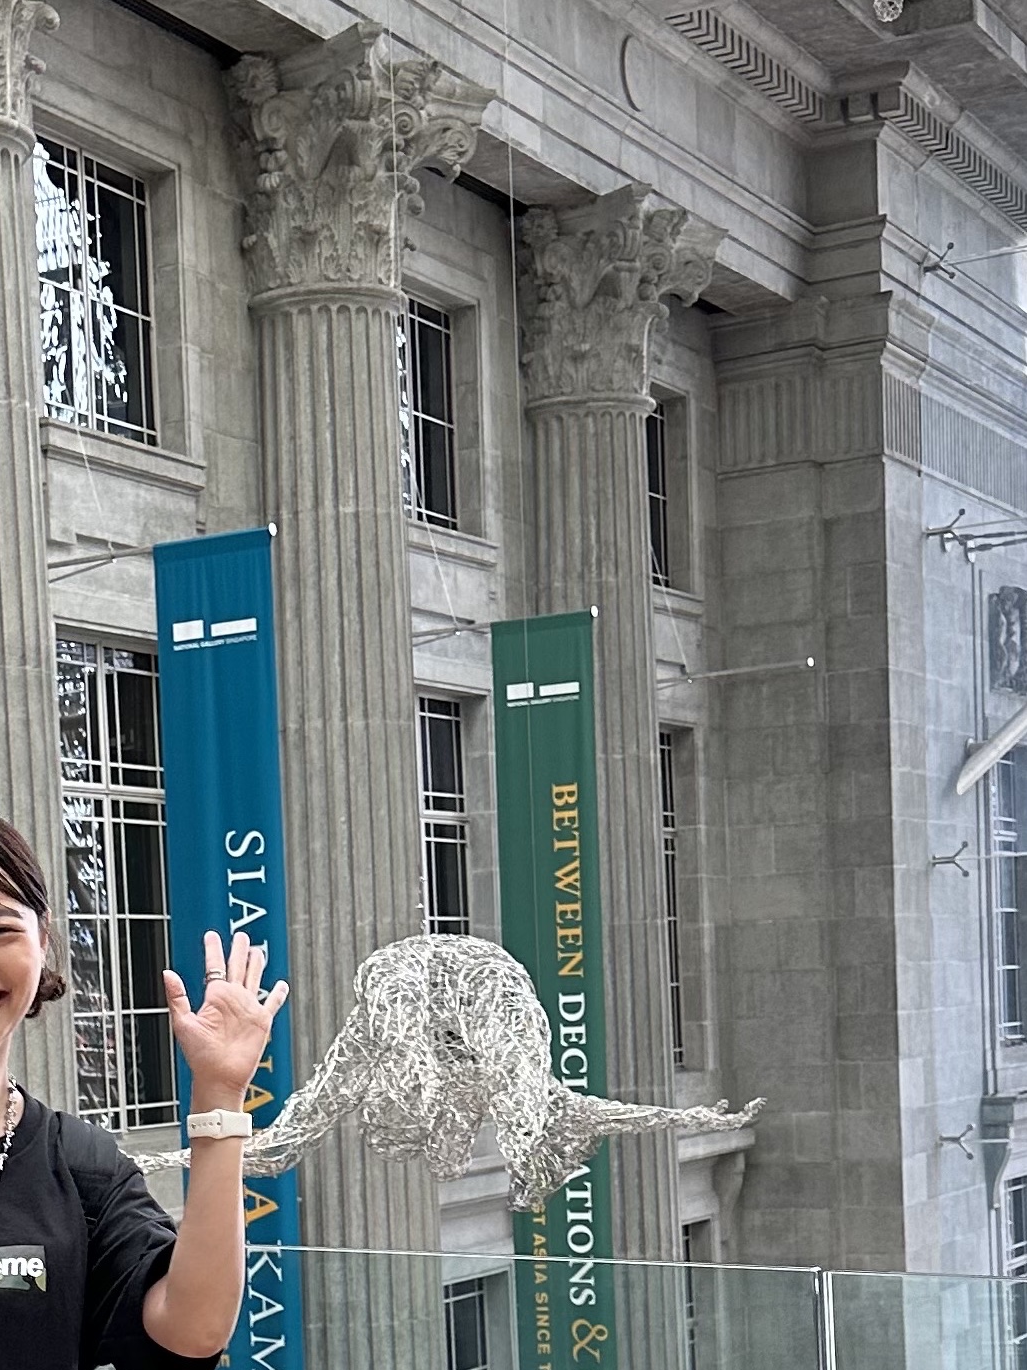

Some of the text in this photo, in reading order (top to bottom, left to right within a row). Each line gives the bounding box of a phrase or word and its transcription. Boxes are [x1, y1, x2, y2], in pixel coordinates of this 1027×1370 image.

[553, 784, 584, 977] BETWEEN
[571, 1319, 608, 1364] &
[532, 1233, 548, 1285] ASIA
[535, 1292, 549, 1355] SINCE
